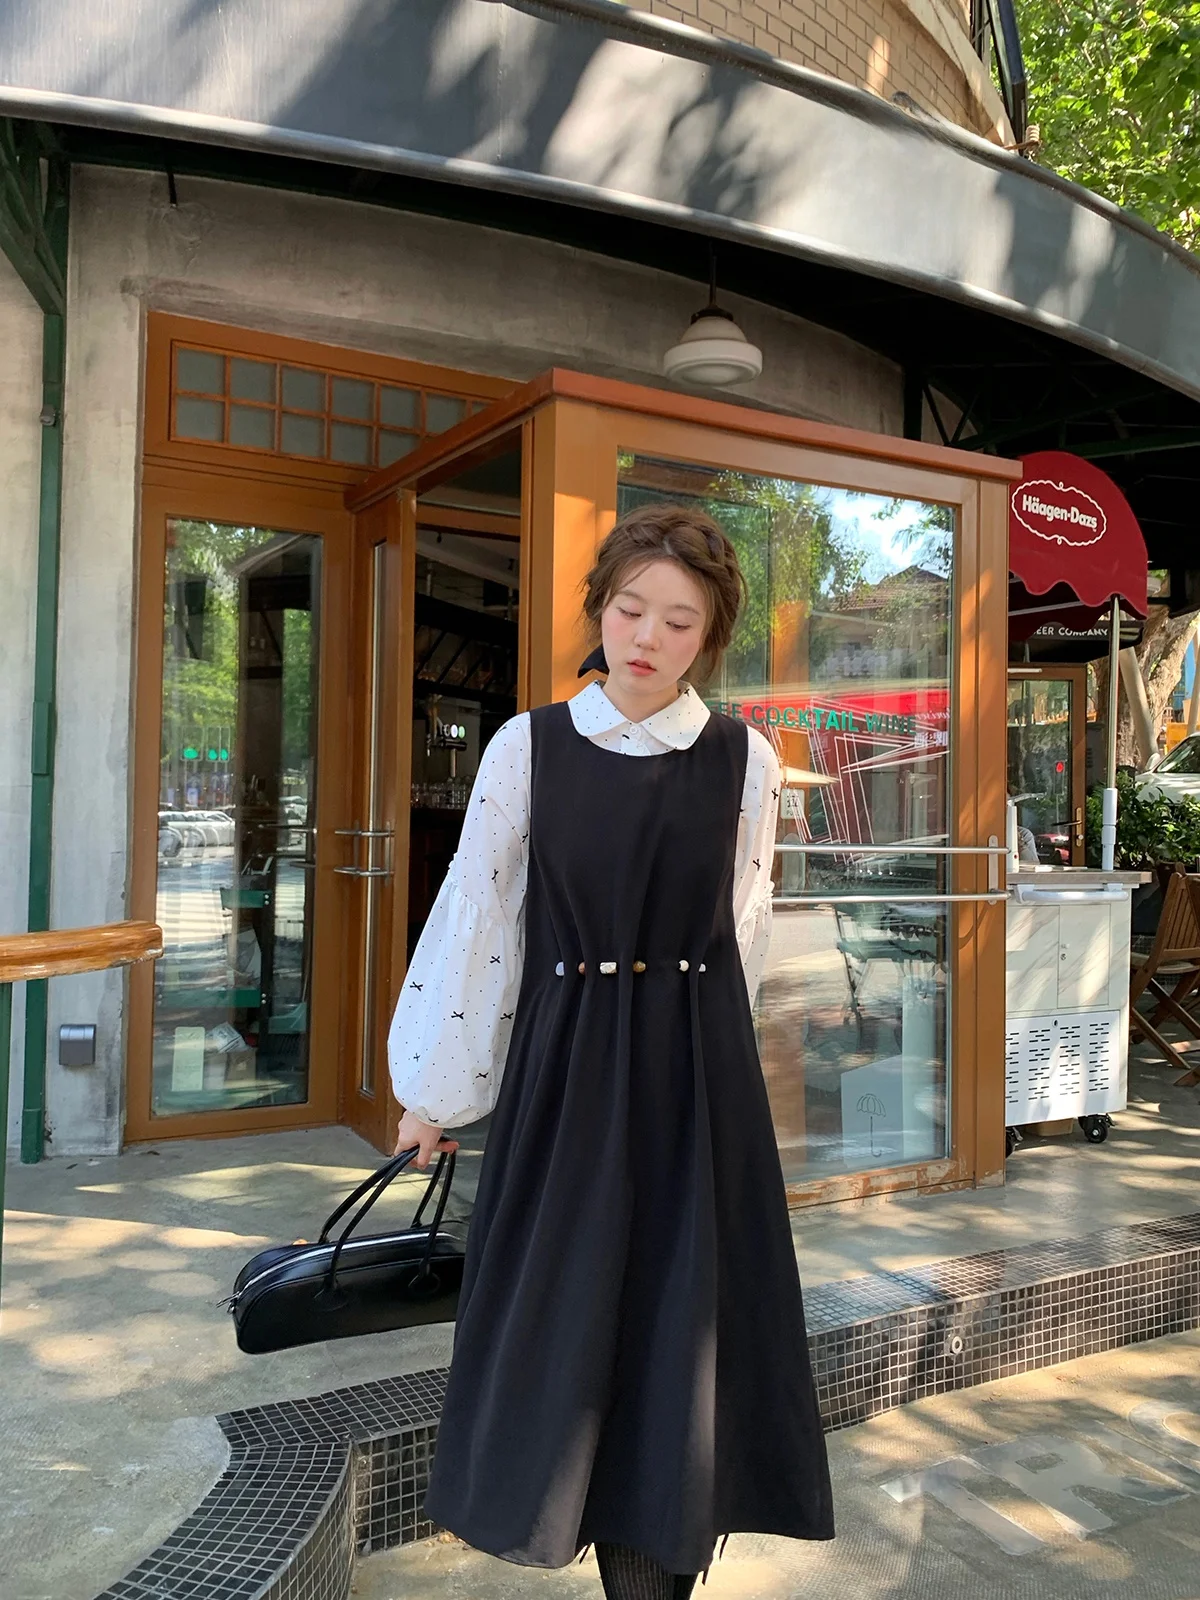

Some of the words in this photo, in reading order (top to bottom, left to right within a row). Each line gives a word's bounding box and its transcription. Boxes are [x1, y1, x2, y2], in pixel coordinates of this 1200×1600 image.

[1022, 494, 1098, 528] Häagen-Dazs
[1034, 626, 1055, 636] EER
[751, 705, 859, 732] COCKTAIL
[865, 712, 917, 735] WINE
